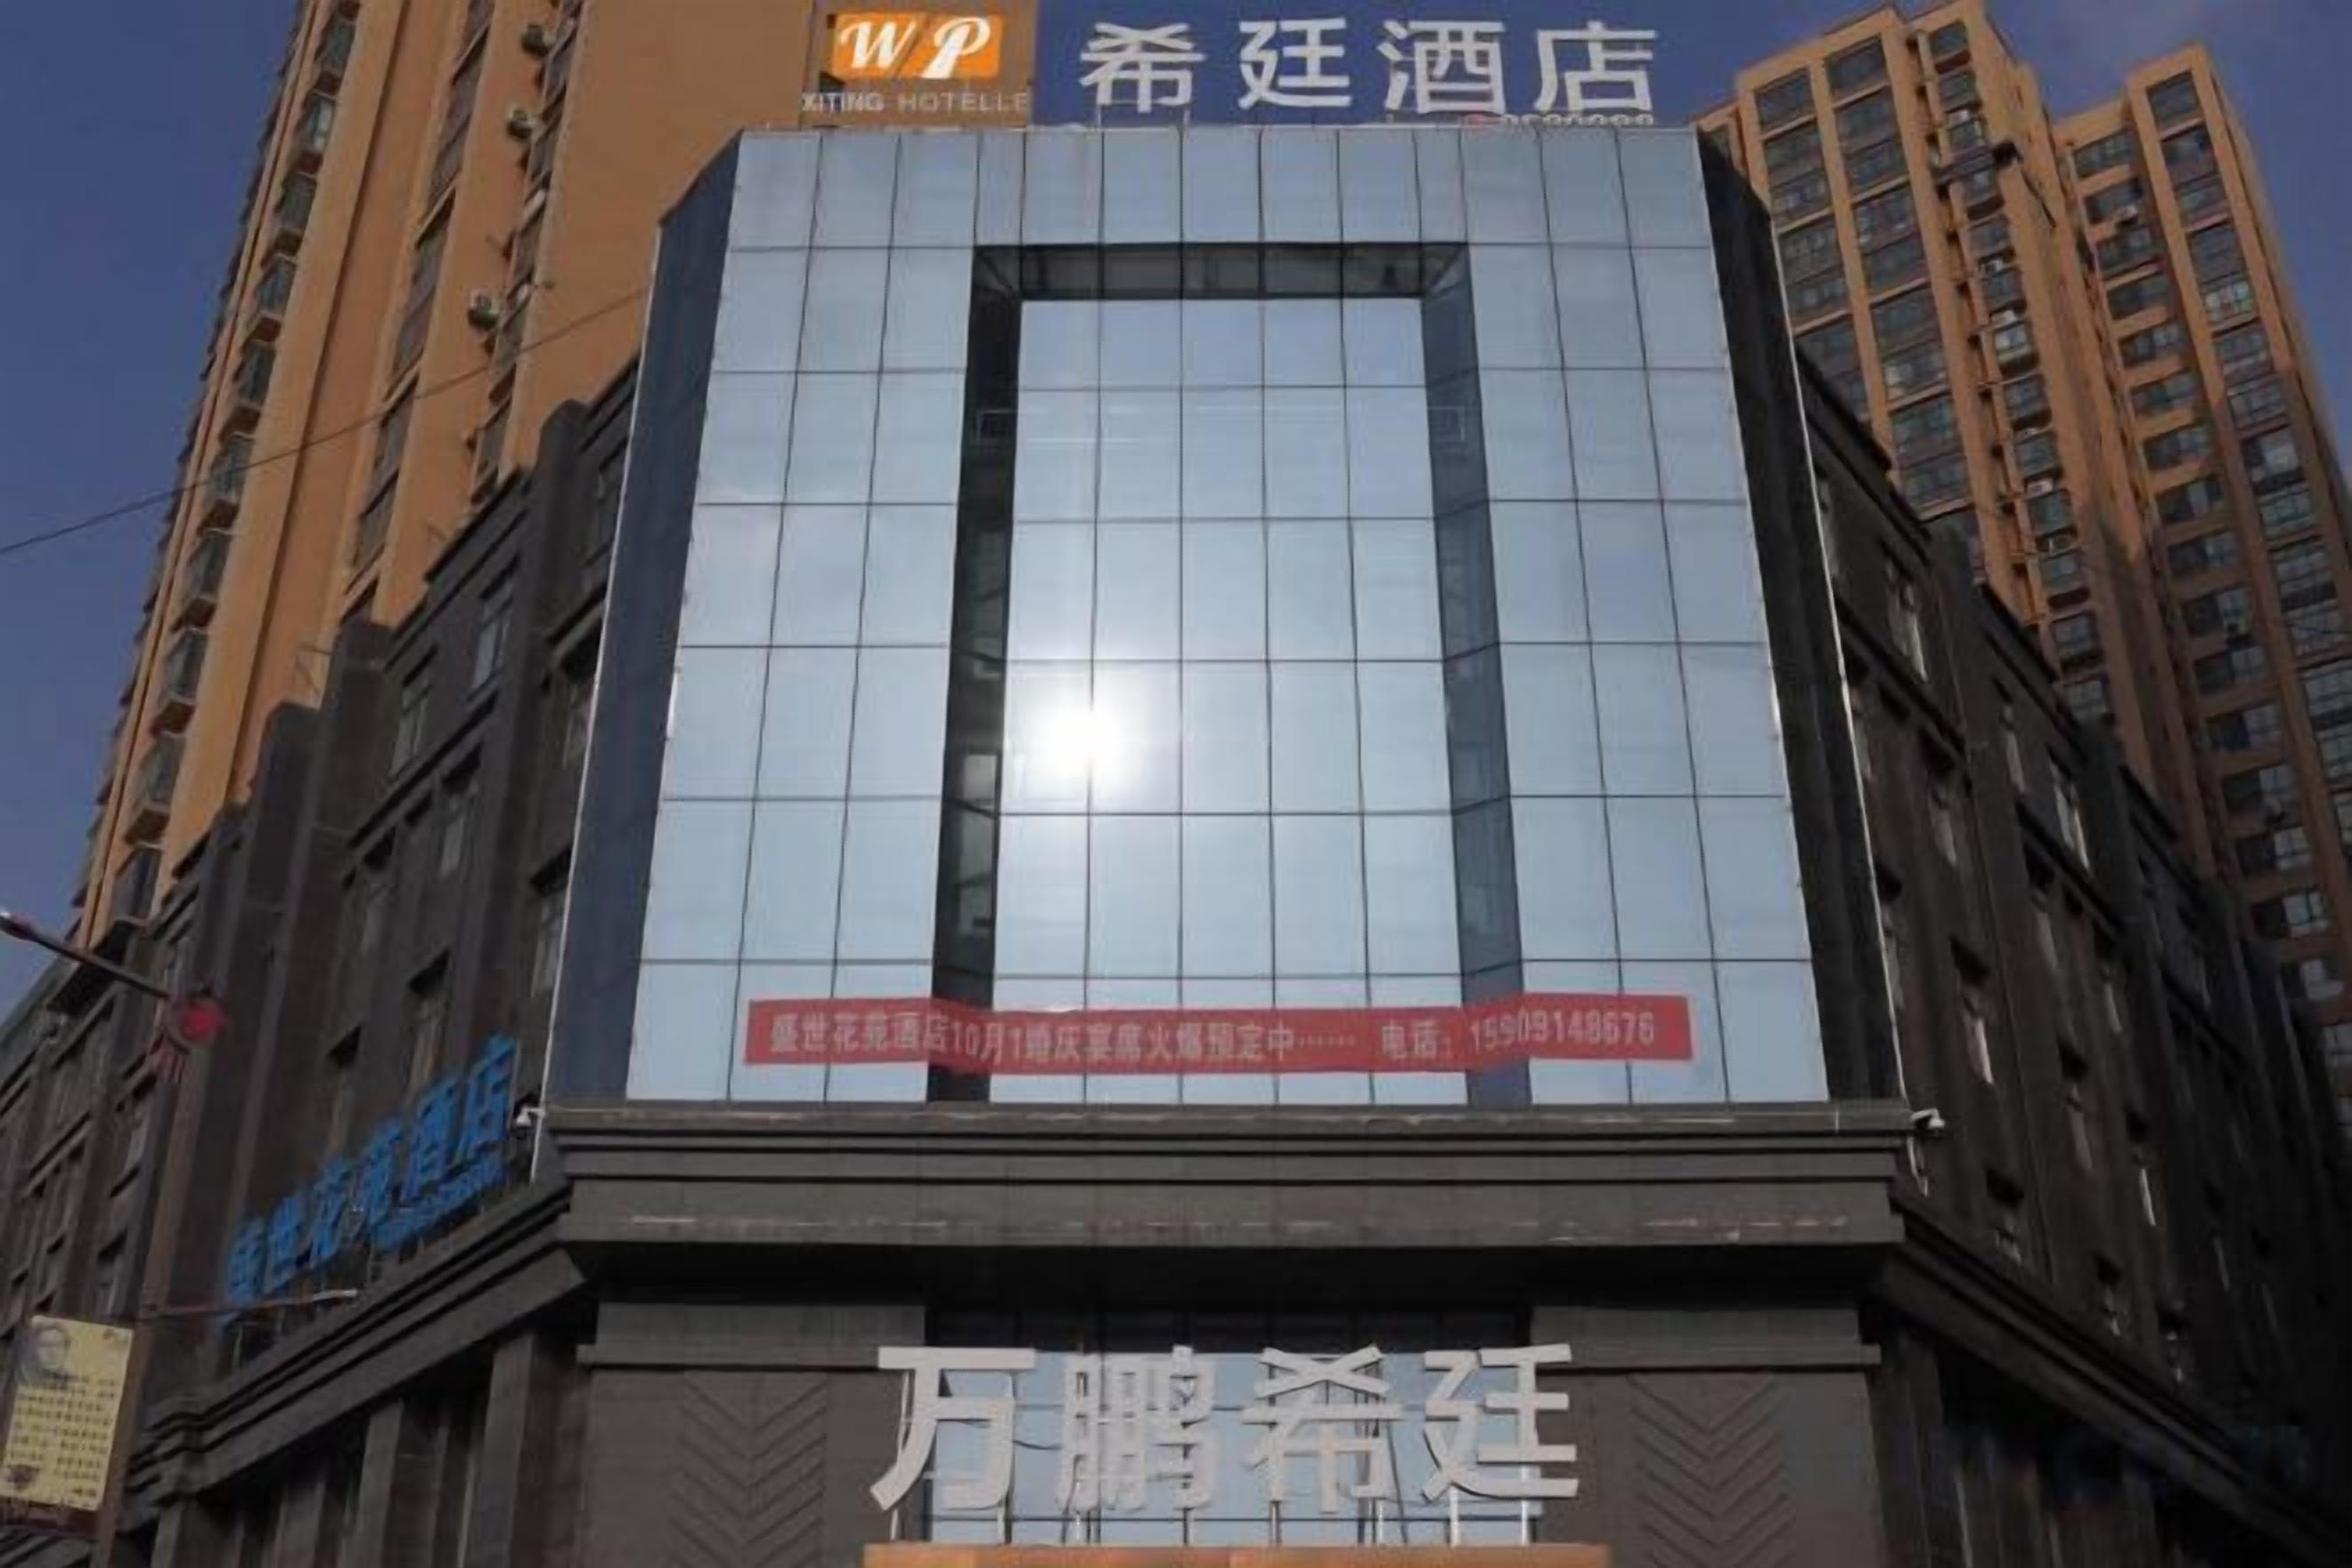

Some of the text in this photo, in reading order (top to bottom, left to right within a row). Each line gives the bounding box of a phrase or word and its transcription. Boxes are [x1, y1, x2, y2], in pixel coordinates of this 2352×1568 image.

[840, 16, 991, 79] WP
[1079, 20, 1657, 115] 希廷酒店
[870, 1344, 1580, 1512] 万鹏希廷
